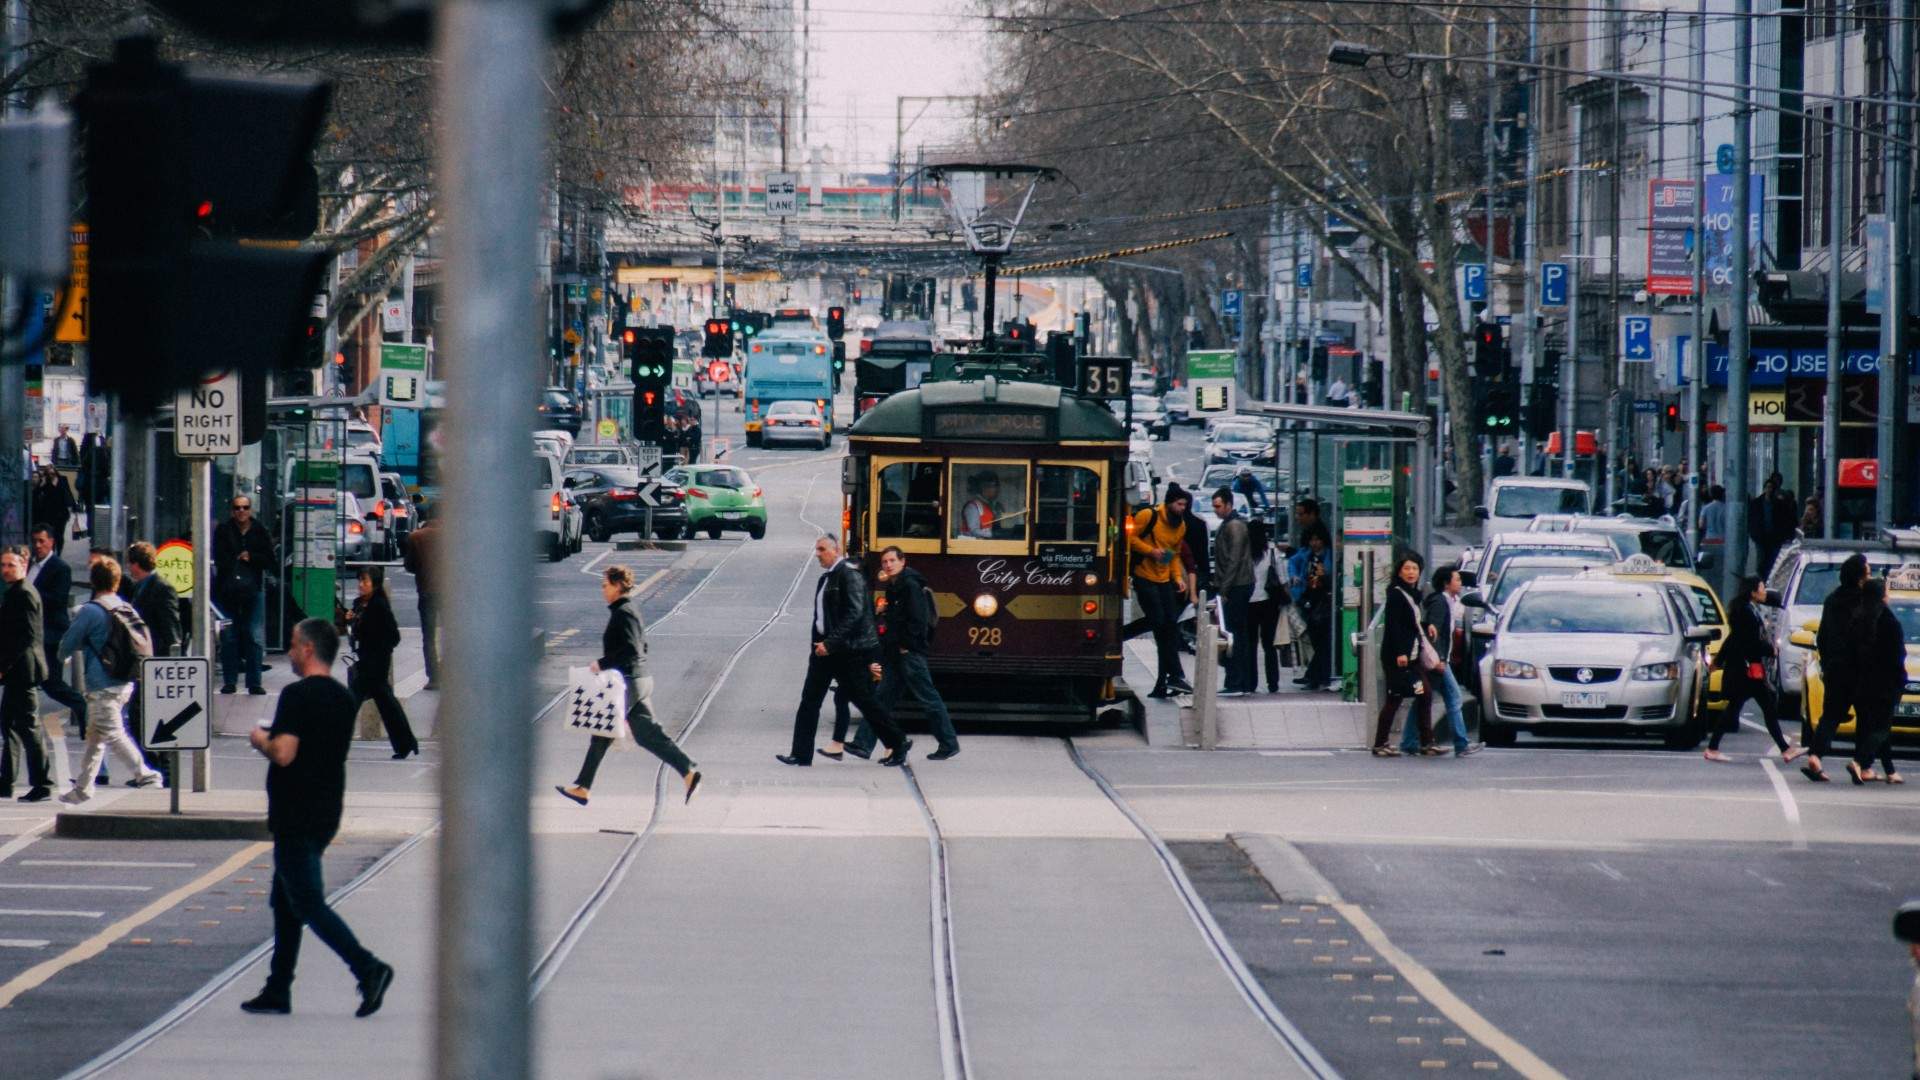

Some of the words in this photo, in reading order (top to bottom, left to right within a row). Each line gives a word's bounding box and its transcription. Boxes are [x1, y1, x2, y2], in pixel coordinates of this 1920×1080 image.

[768, 200, 794, 210] LANE
[1086, 366, 1120, 393] 35
[191, 389, 224, 409] NO
[183, 414, 233, 428] RIGHT
[185, 433, 231, 447] TURN
[1042, 554, 1053, 562] via
[1054, 554, 1083, 562] Flinders
[1085, 554, 1093, 563] St
[976, 559, 1021, 592] City
[1023, 560, 1076, 586] Circle
[968, 627, 1002, 646] 928
[154, 666, 198, 680] KEEP
[156, 685, 196, 699] LEFT
